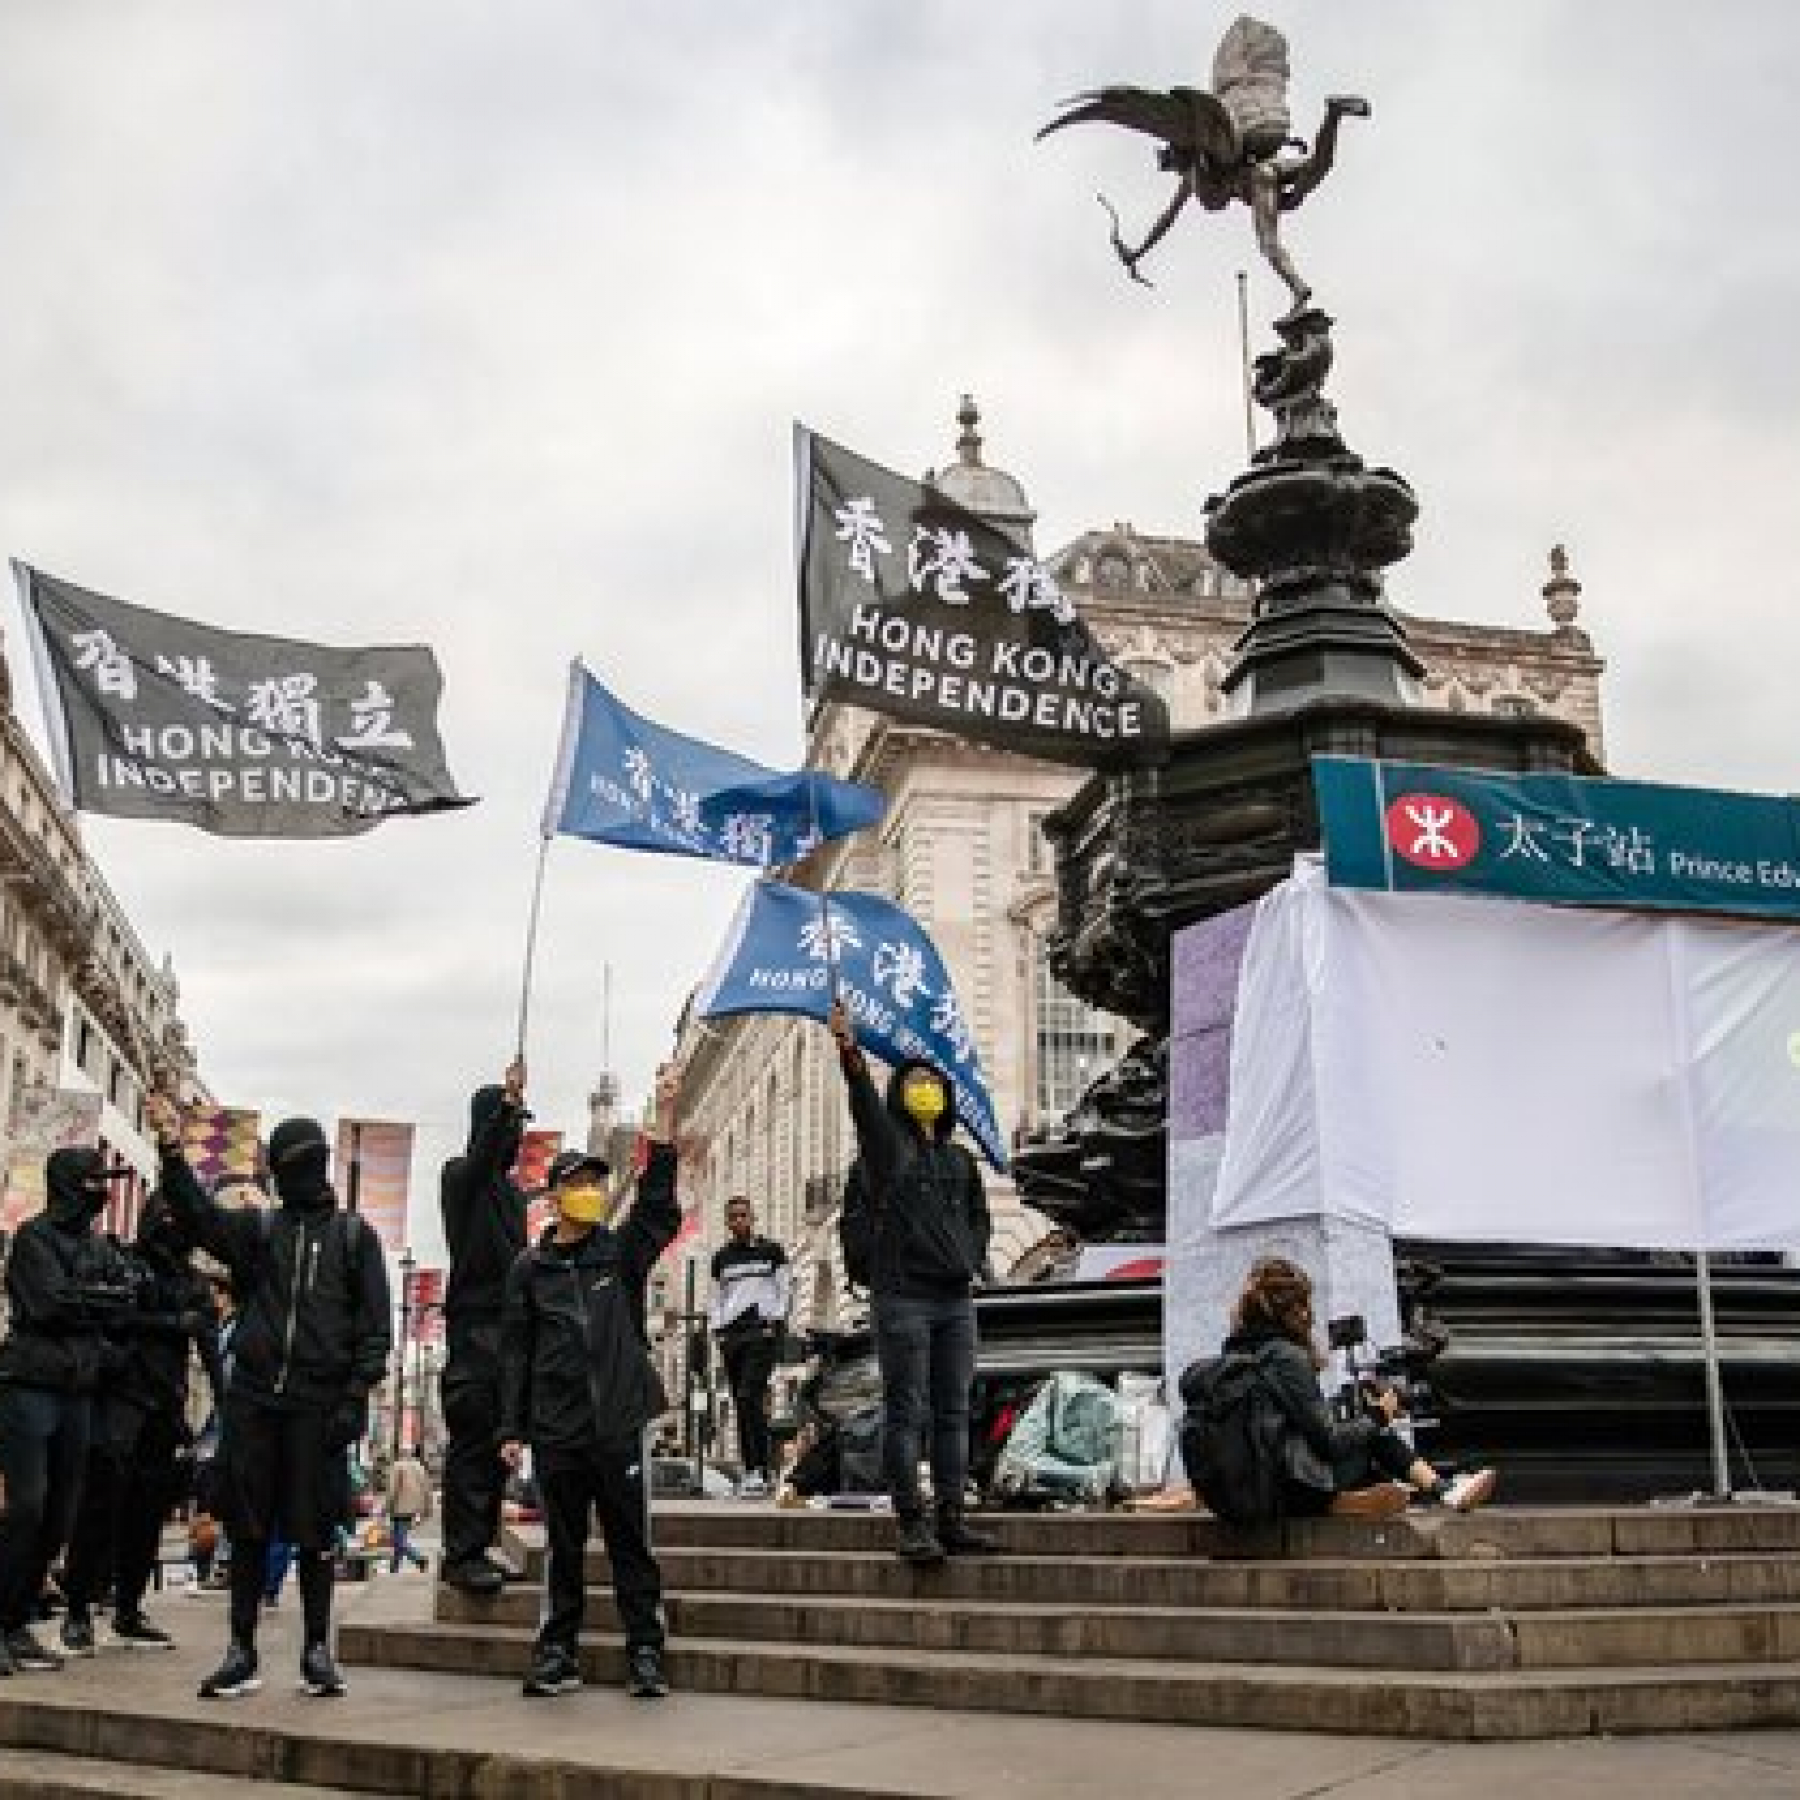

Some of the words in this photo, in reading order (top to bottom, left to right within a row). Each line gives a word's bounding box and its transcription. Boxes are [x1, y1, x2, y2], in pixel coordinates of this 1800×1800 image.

[850, 602, 976, 670] HONG
[993, 640, 1119, 698] KONG
[813, 631, 1142, 738] INDEPENDENCE
[122, 725, 271, 760] HONG
[97, 752, 406, 813] INDEPENDEN
[1496, 812, 1656, 875] 太子站
[1669, 851, 1753, 884] Prince
